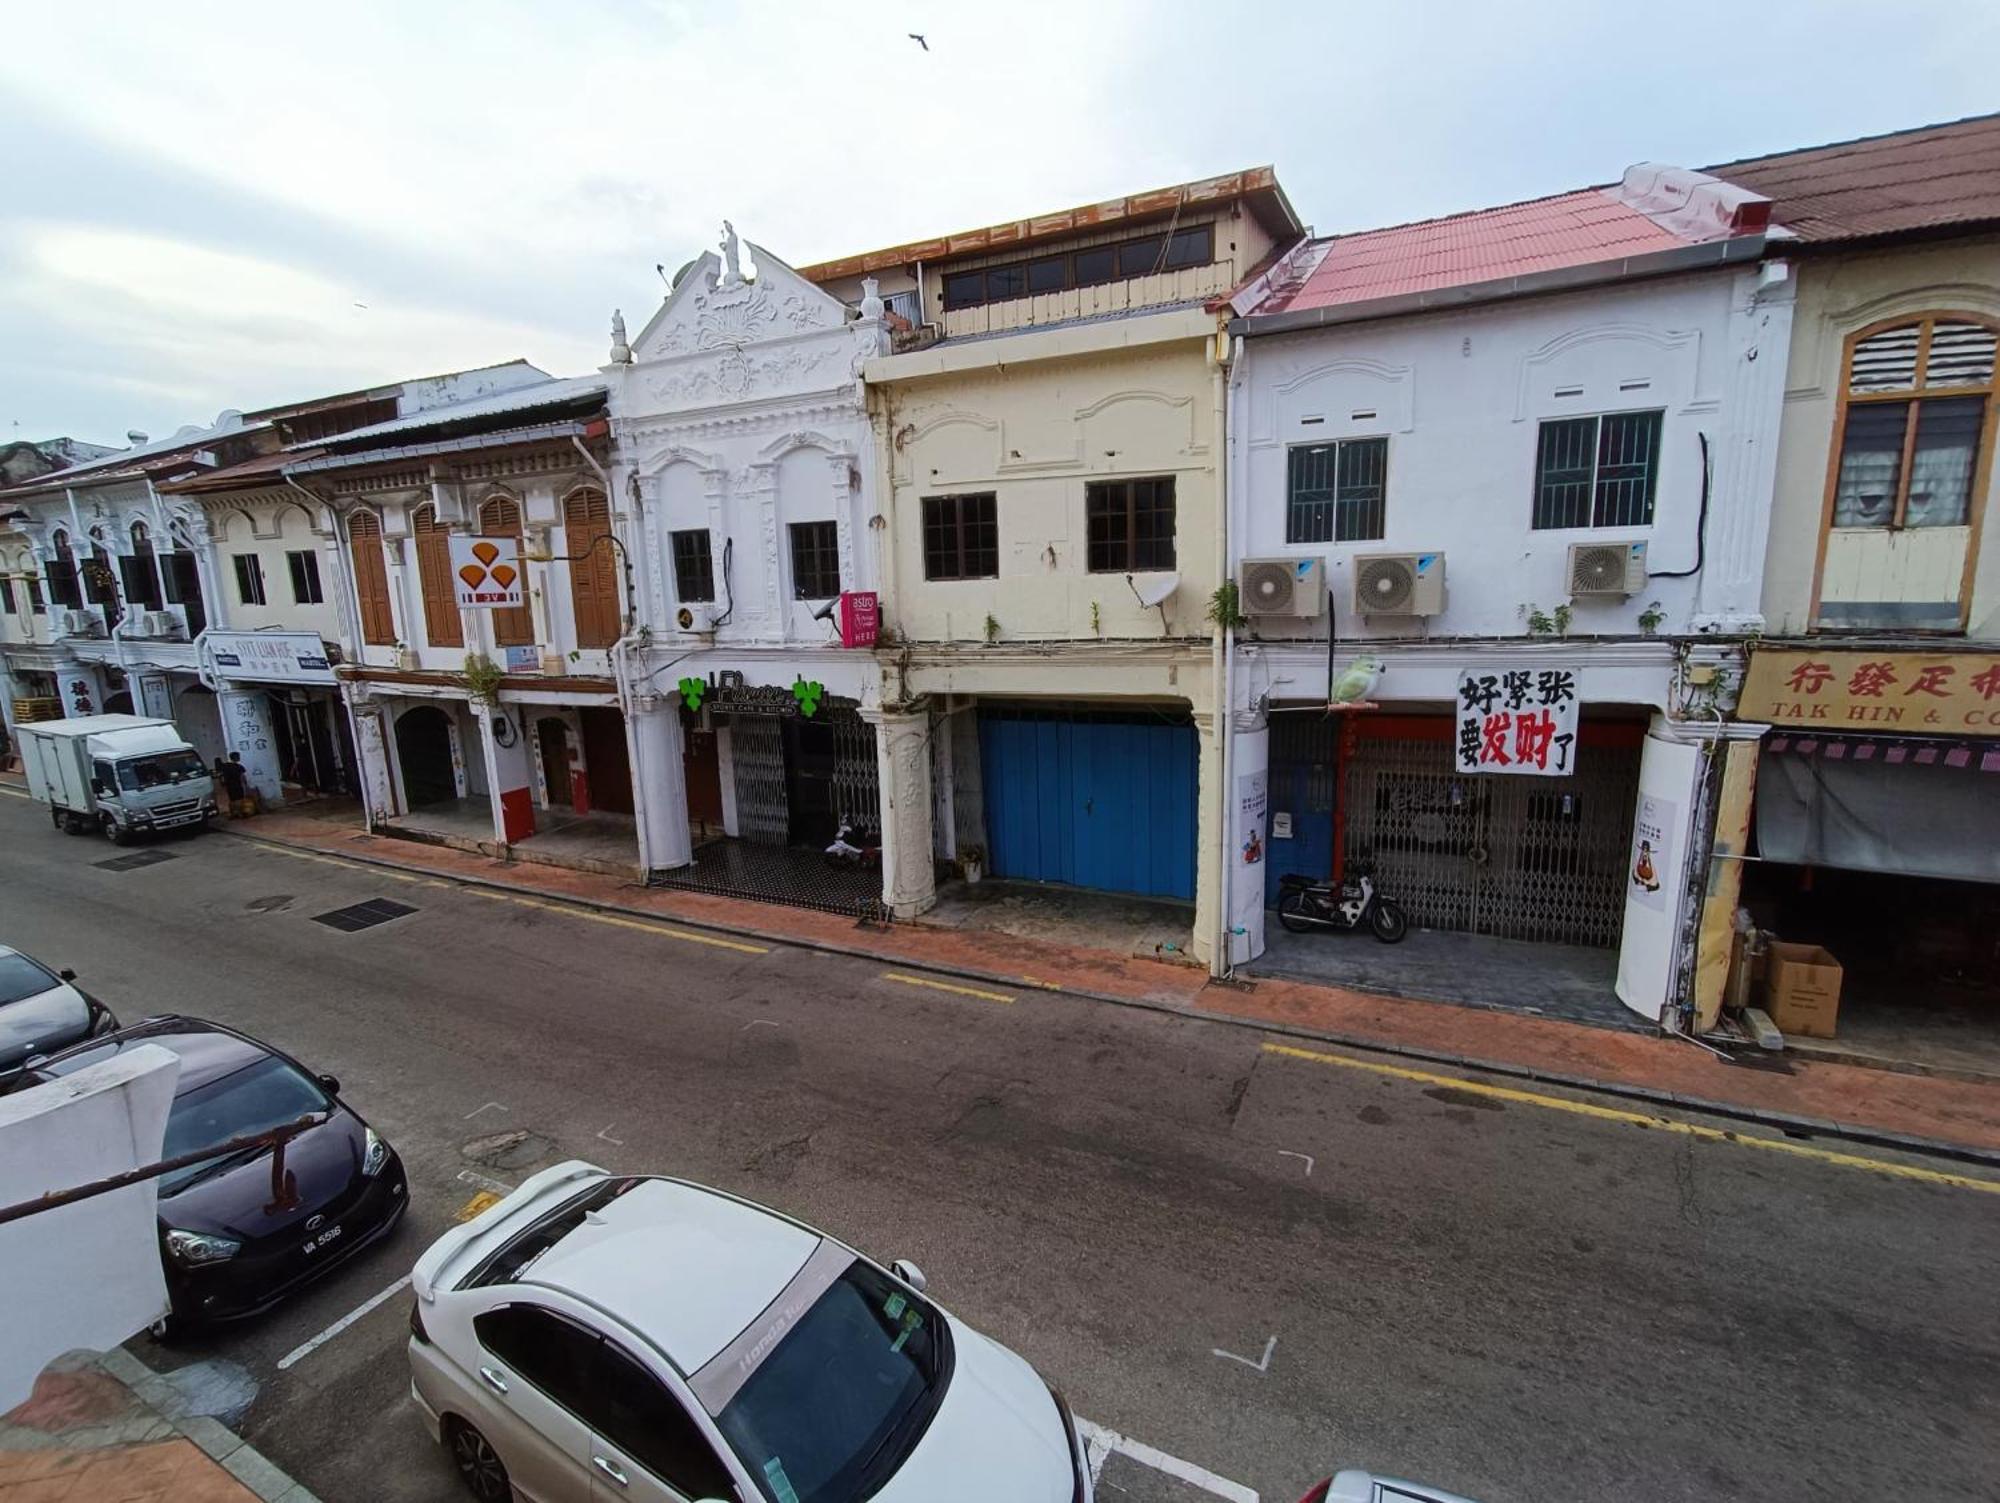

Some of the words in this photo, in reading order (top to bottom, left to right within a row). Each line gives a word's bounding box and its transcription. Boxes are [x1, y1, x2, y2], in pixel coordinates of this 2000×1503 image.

[853, 595, 874, 608] astro
[1771, 702, 1831, 719] TAK
[1847, 705, 1906, 722] HIN
[1923, 709, 1941, 724] &
[1459, 708, 1574, 771] 要发财了
